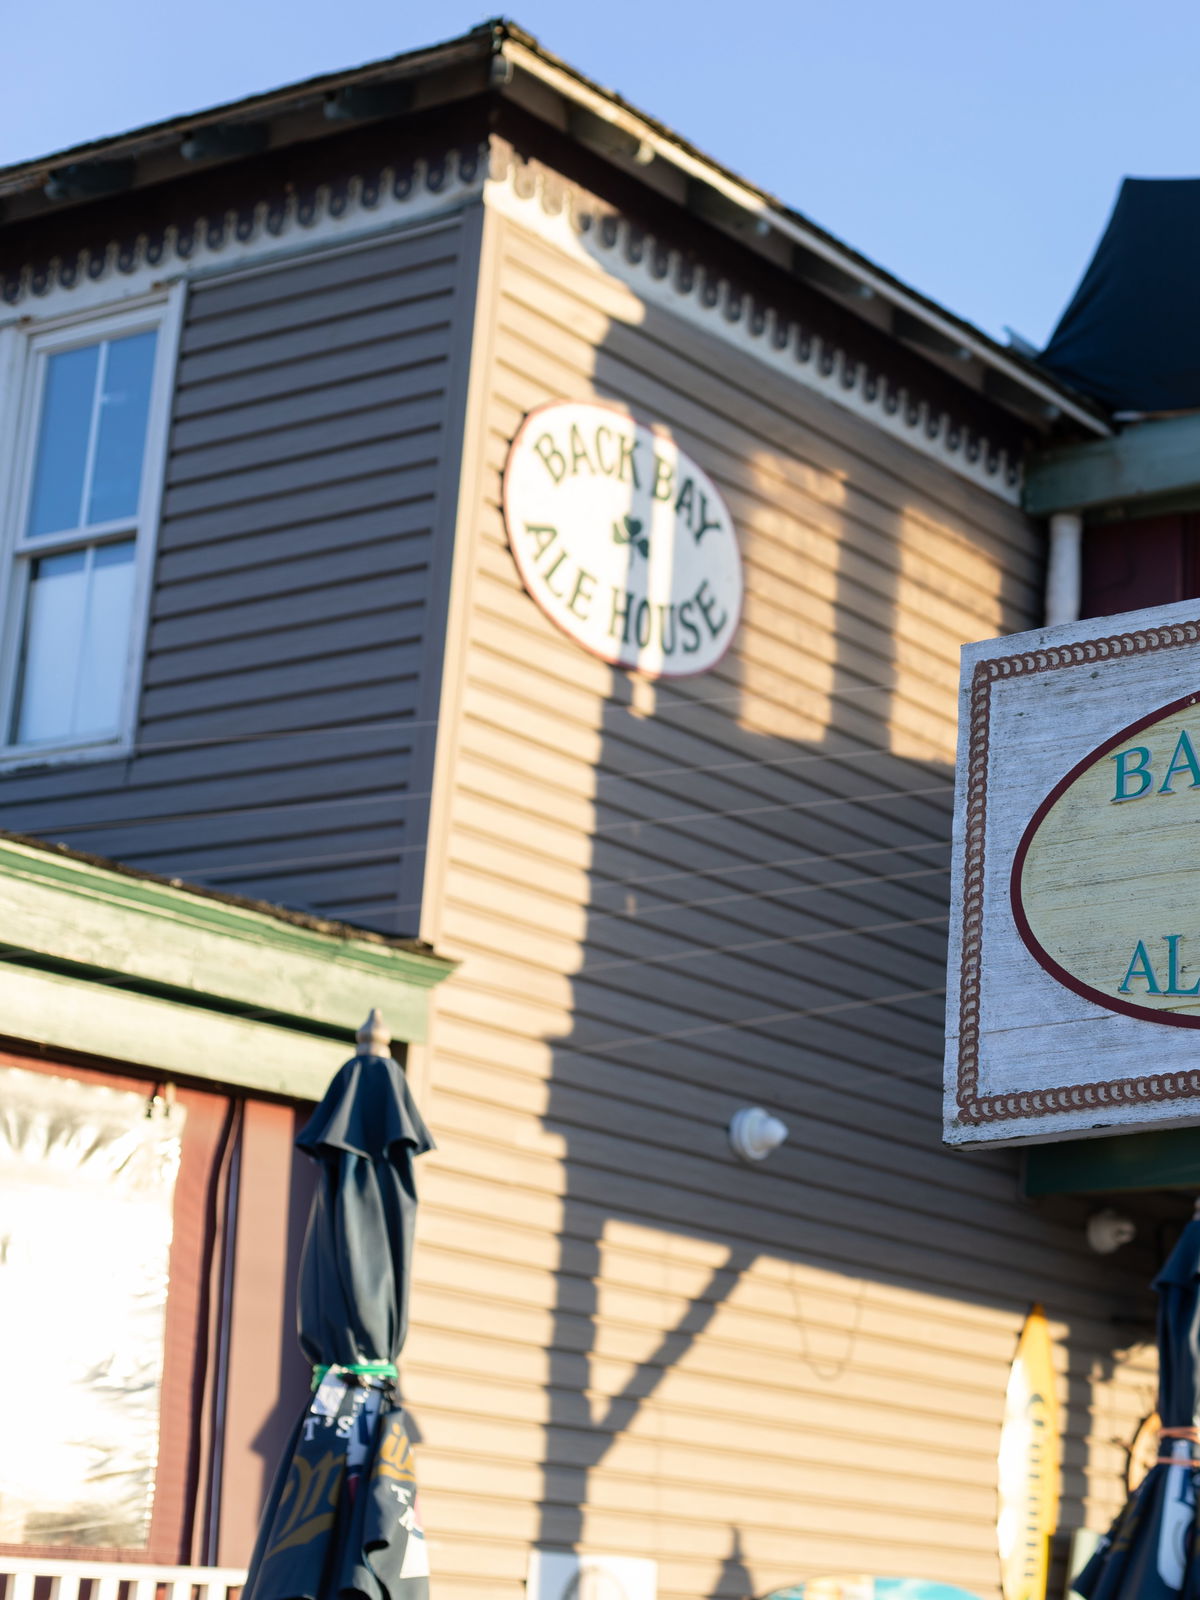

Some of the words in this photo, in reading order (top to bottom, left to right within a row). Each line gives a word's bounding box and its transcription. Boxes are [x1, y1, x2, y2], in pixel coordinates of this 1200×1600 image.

[533, 423, 641, 491] BACK
[651, 455, 722, 545] BAY
[523, 520, 597, 621] ALE
[607, 578, 727, 656] HOUSE
